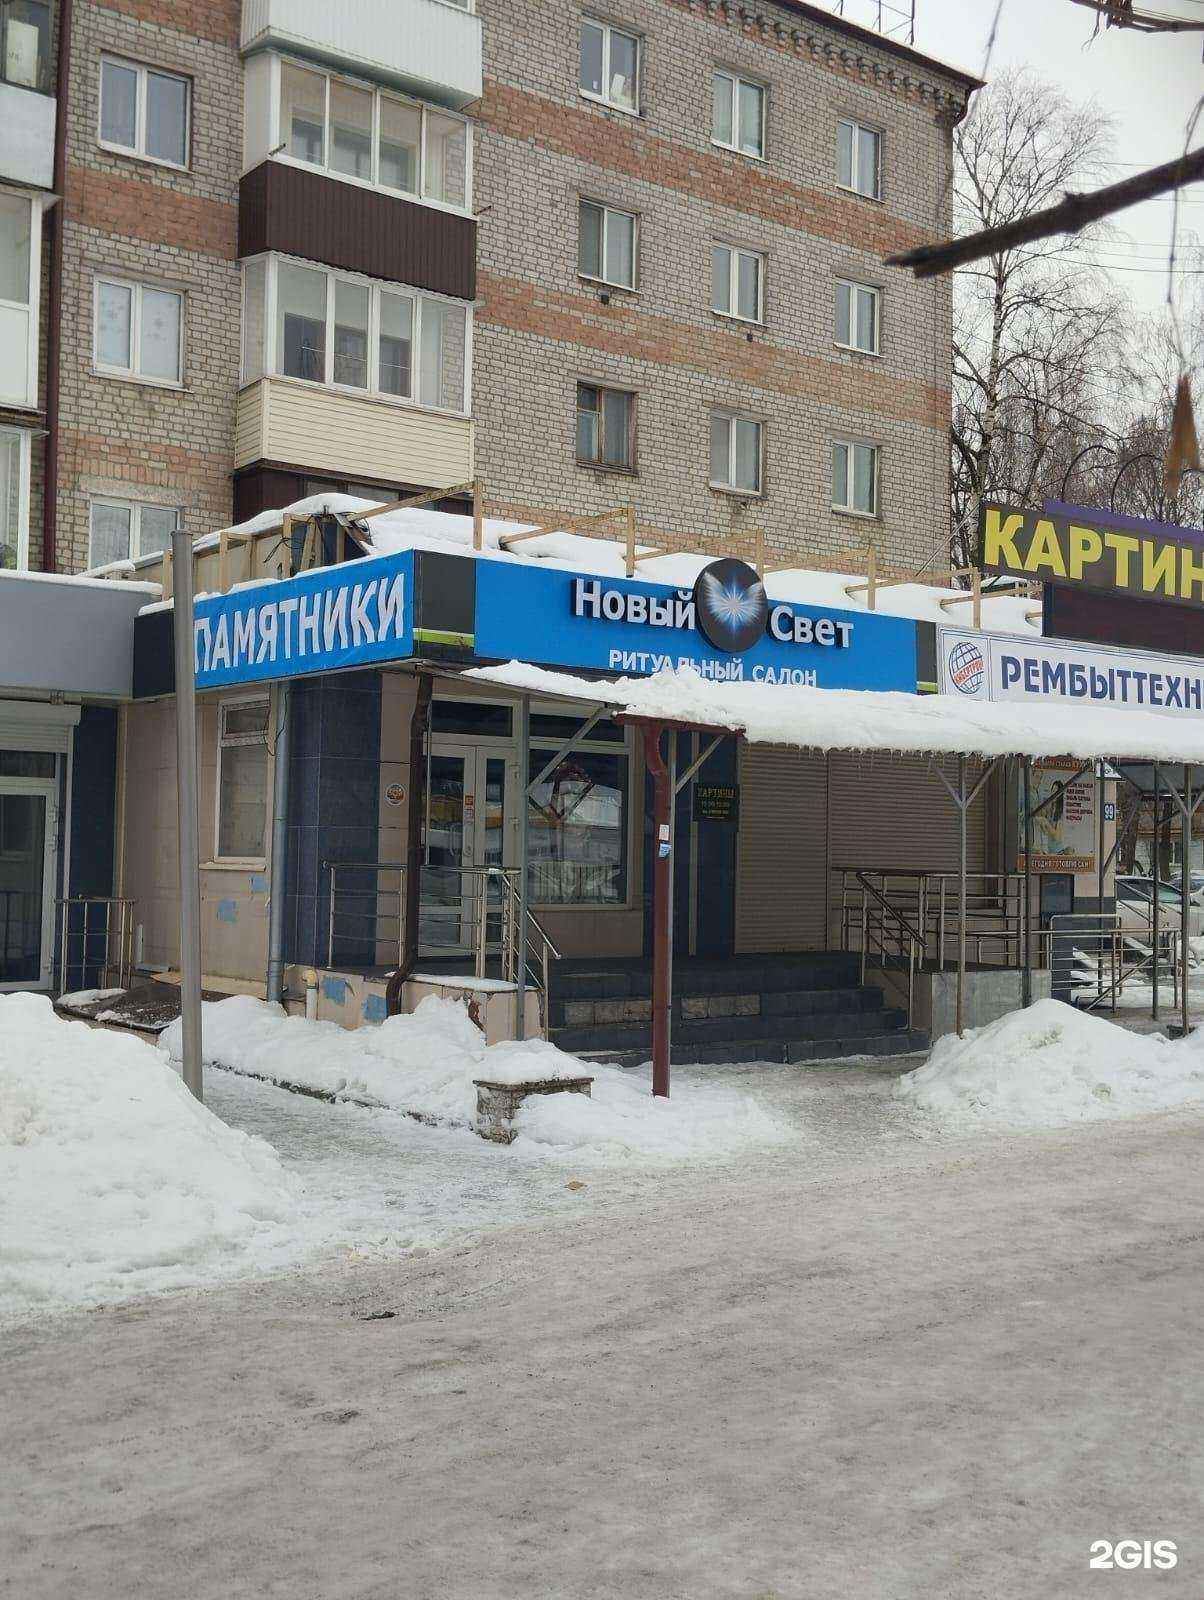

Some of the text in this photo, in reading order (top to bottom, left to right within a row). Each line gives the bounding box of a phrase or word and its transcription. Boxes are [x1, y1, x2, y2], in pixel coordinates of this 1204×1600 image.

[984, 509, 1204, 601] КАРТИН
[194, 573, 404, 674] ПАМЯТНИКИ
[574, 578, 854, 648] Новый Свет
[752, 665, 817, 686] САЛОН
